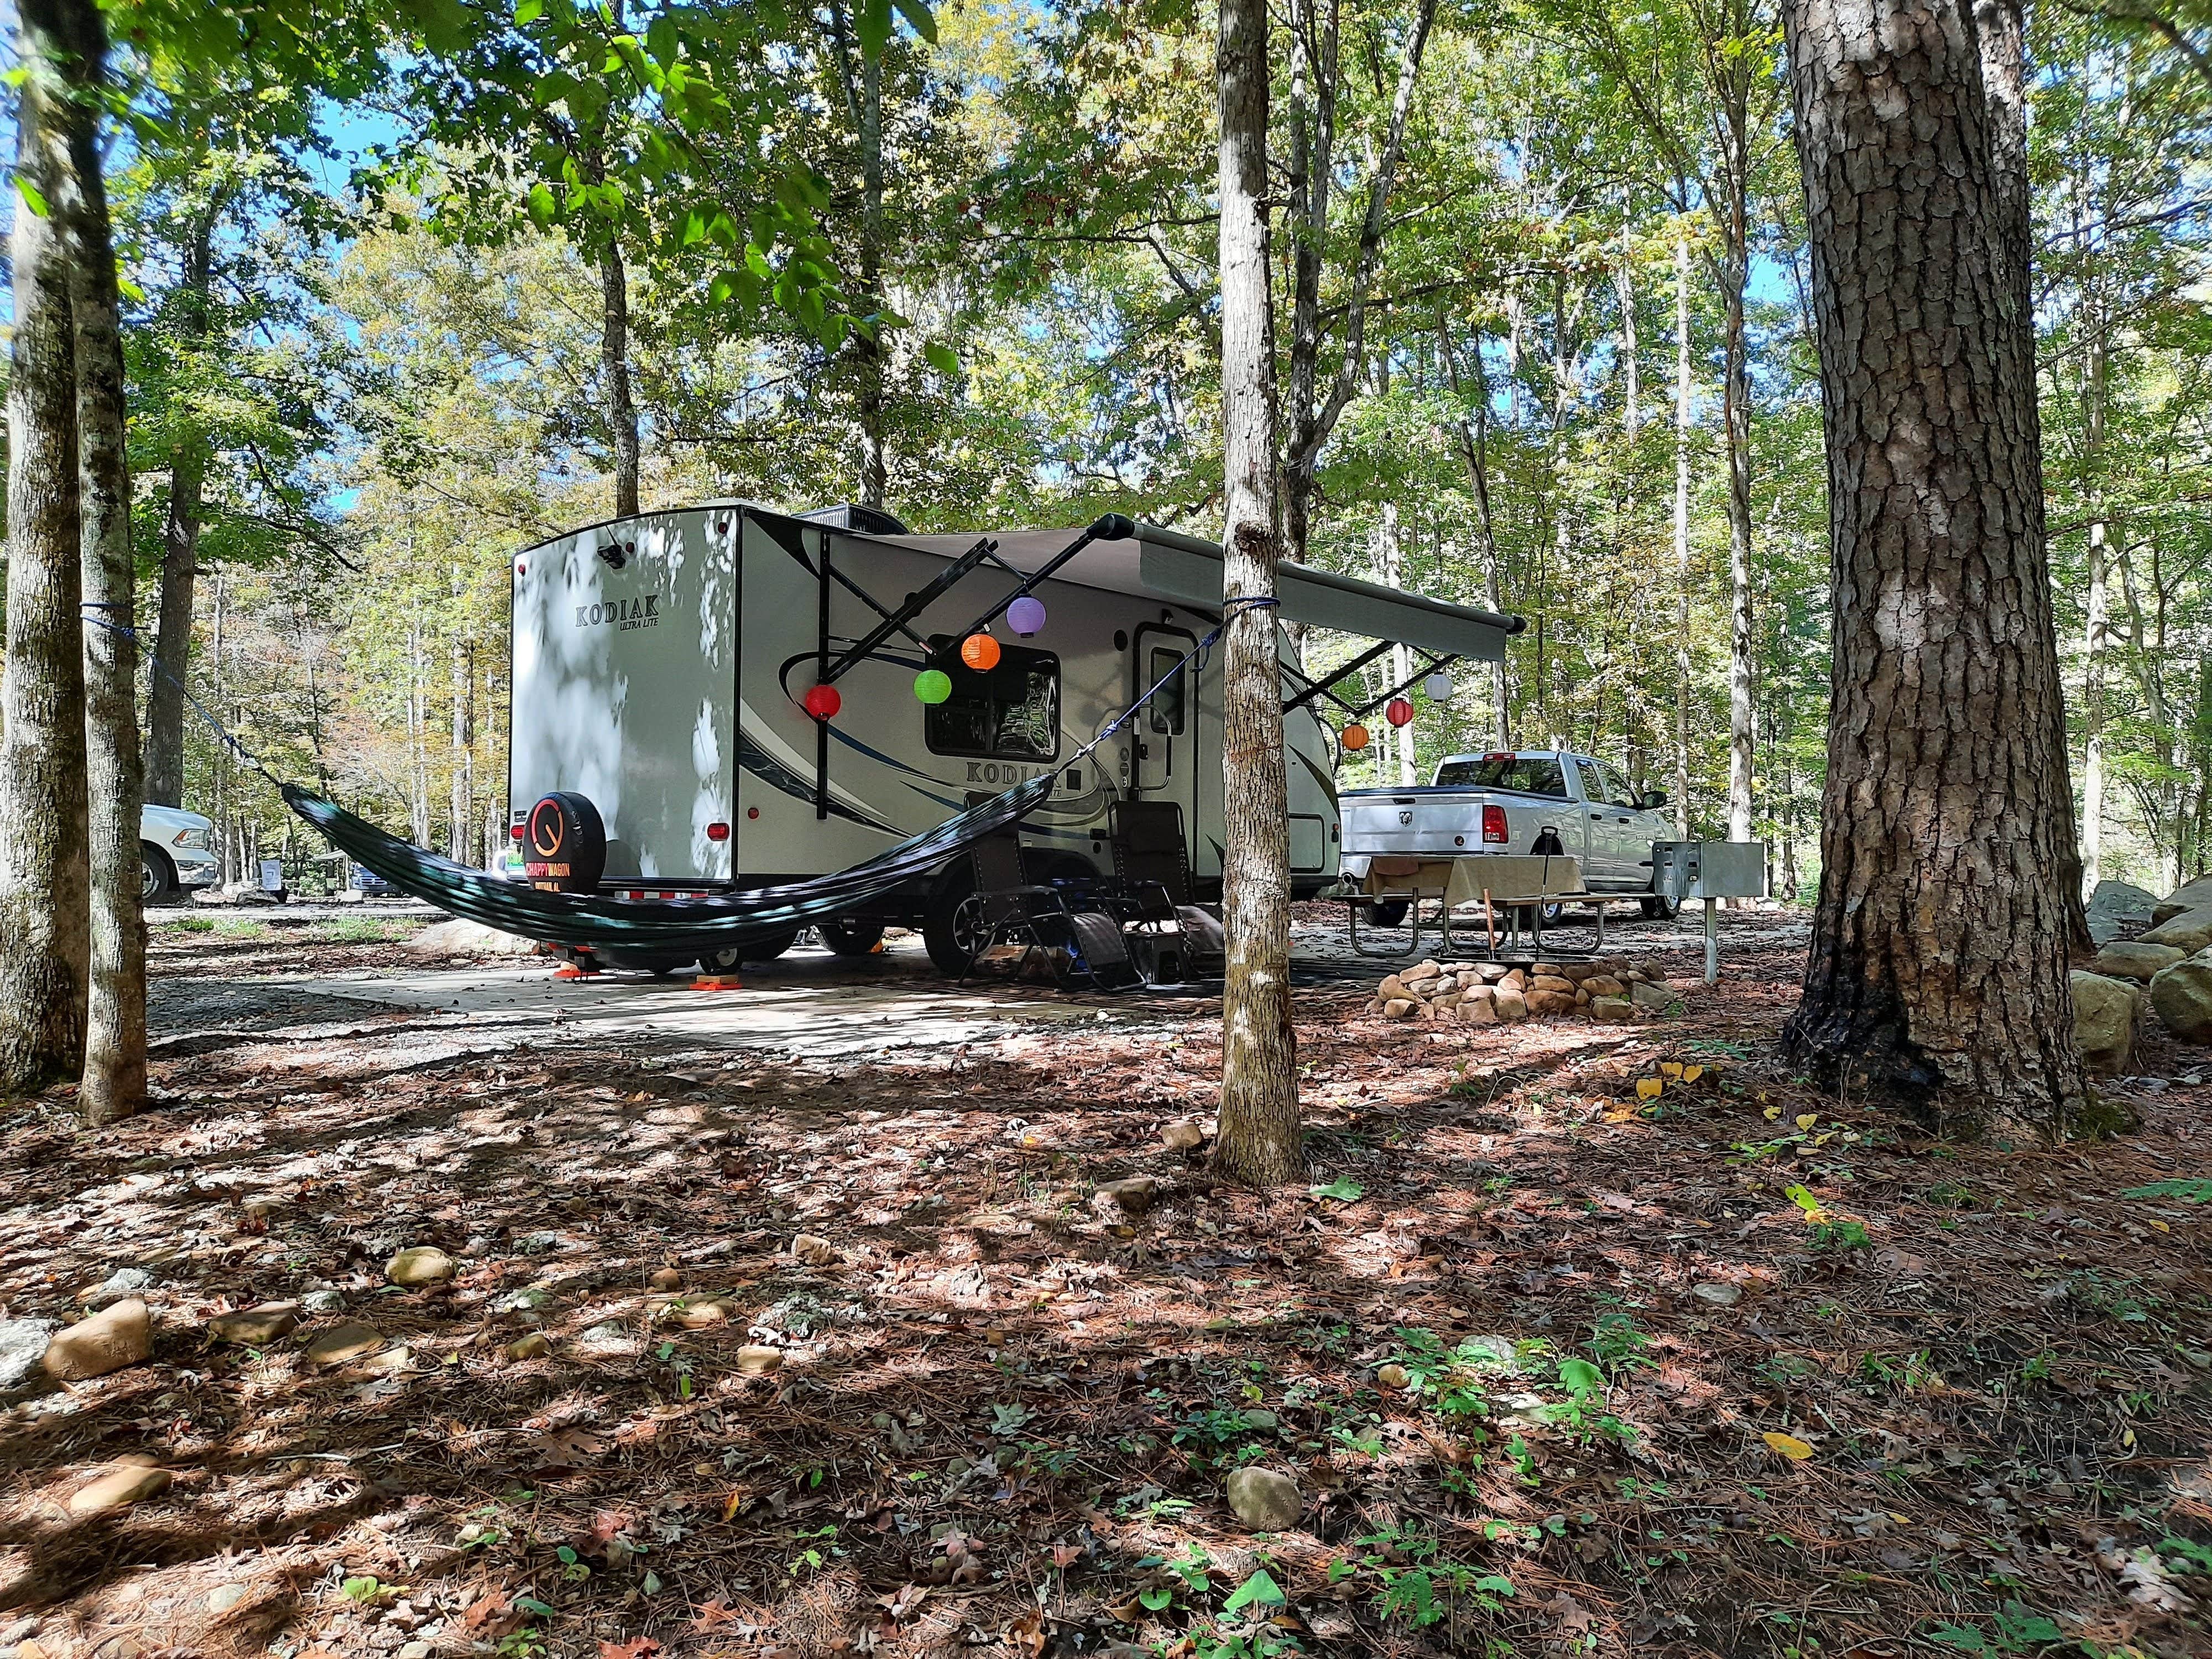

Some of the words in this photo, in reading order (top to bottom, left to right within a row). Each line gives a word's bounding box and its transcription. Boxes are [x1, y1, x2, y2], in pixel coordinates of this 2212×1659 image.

[576, 594, 659, 627] KODIAK
[620, 620, 640, 631] ULTRA
[643, 618, 659, 628] LITE
[526, 862, 570, 877] CHAPPYWAGON
